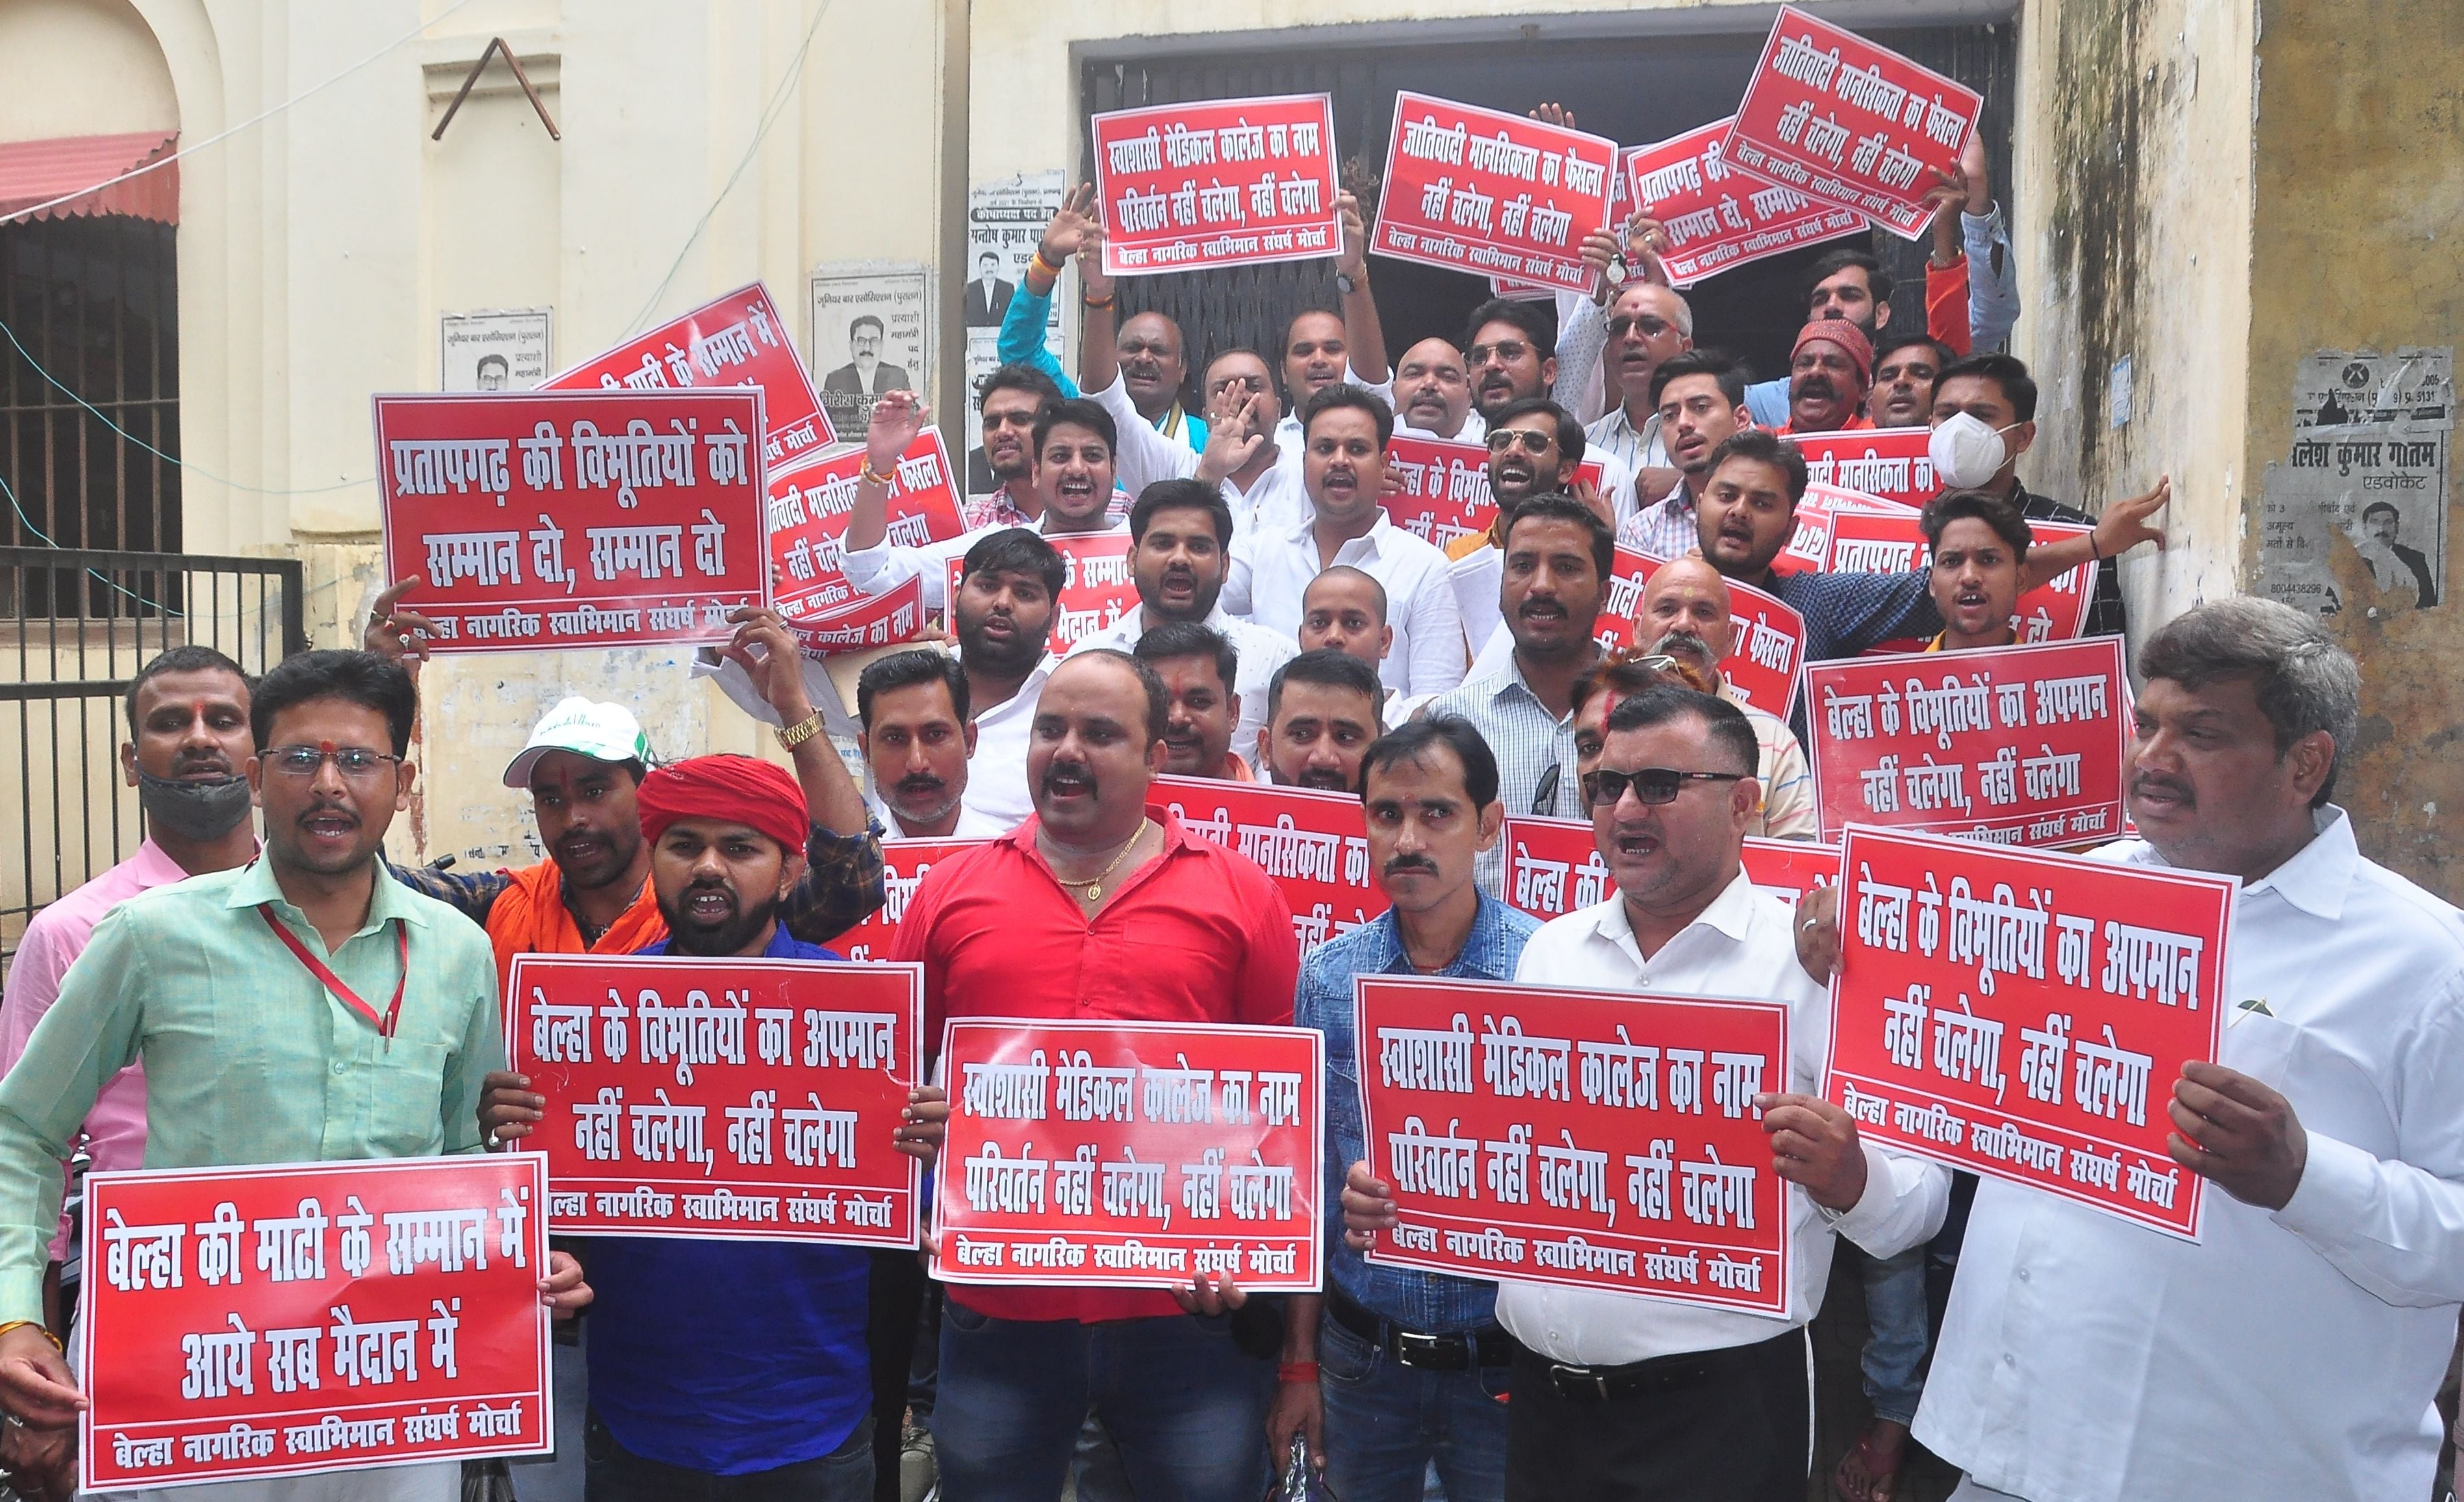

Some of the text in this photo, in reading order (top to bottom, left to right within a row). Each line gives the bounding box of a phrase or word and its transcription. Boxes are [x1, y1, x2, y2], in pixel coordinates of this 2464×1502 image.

[1772, 34, 1967, 149] जातिवादी मानसिकता का फैसला
[1107, 117, 1320, 175] स्वाशासी मेडिकल कालेज का नाम
[1402, 115, 1467, 166] जातिवादी
[1468, 131, 1540, 181] मानसिकता
[1541, 151, 1563, 186] का
[1564, 147, 1606, 197] फैसला
[1777, 100, 1814, 144] नहीं
[1851, 133, 1889, 175] नहीं
[1877, 143, 1923, 190] चलेगा
[1116, 184, 1169, 233] परिवर्तन
[1170, 179, 1198, 225] नहीं
[1248, 172, 1277, 217] नहीं
[1278, 170, 1320, 215] चलेगा
[1421, 177, 1453, 221] नहीं
[1500, 194, 1532, 237] नहीं
[1530, 199, 1572, 246] चलेगा
[689, 322, 758, 377] सम्मान
[747, 300, 778, 348] में
[391, 417, 748, 508] प्रतापगढ़ की विभूतियों को
[783, 420, 817, 449] मोर्चा
[1838, 448, 1911, 494] मानसिकता
[1428, 456, 1446, 498] के
[2363, 471, 2427, 489] एडवोकेट
[422, 508, 726, 594] सम्मान दो, सम्मान दो
[784, 537, 815, 581] नहीं
[464, 607, 541, 639] नागरिक
[547, 604, 642, 635] स्वाभिमान
[647, 600, 698, 632] संघर्ष
[805, 584, 849, 609] नागरिक
[818, 622, 866, 644] कालेज
[869, 616, 889, 644] का
[891, 601, 914, 637] नाम
[1749, 611, 1796, 674] फैसला
[1824, 671, 2108, 746] बेल्हा के विभूतियों का अपमान
[1860, 744, 2081, 817] नहीं चलेगा, नहीं चलेगा
[1237, 813, 1341, 884] मानसिकता
[1515, 841, 1570, 914] बेल्हा
[1858, 861, 2203, 1010] बेल्हा के विभूतियों का अपमान
[530, 987, 897, 1086] बेल्हा के विभूतियों का अपमान
[1377, 1013, 1765, 1119] स्वाशासी मेडिकल कालेज का नाम
[1884, 984, 2153, 1126] नहीं चलेगा, नहीं चलेगा
[962, 1049, 1302, 1126] स्वाशासी मेडिकल कालेज का नाम
[572, 1086, 858, 1176] नहीं चलेगा, नहीं चलेगा
[964, 1141, 1293, 1228] परिवर्तन नहीं चलेगा, नहीं चलेगा
[1388, 1116, 1756, 1229] परिवर्तन नहीं चलेगा, नहीं चलेगा
[104, 1186, 529, 1291] बेल्हा की माटी के सम्मान में
[181, 1297, 461, 1399] आये सब मैदान में
[112, 1400, 522, 1469] बेल्हा नागरिक स्वाभिमान संघर्ष मोर्चा
